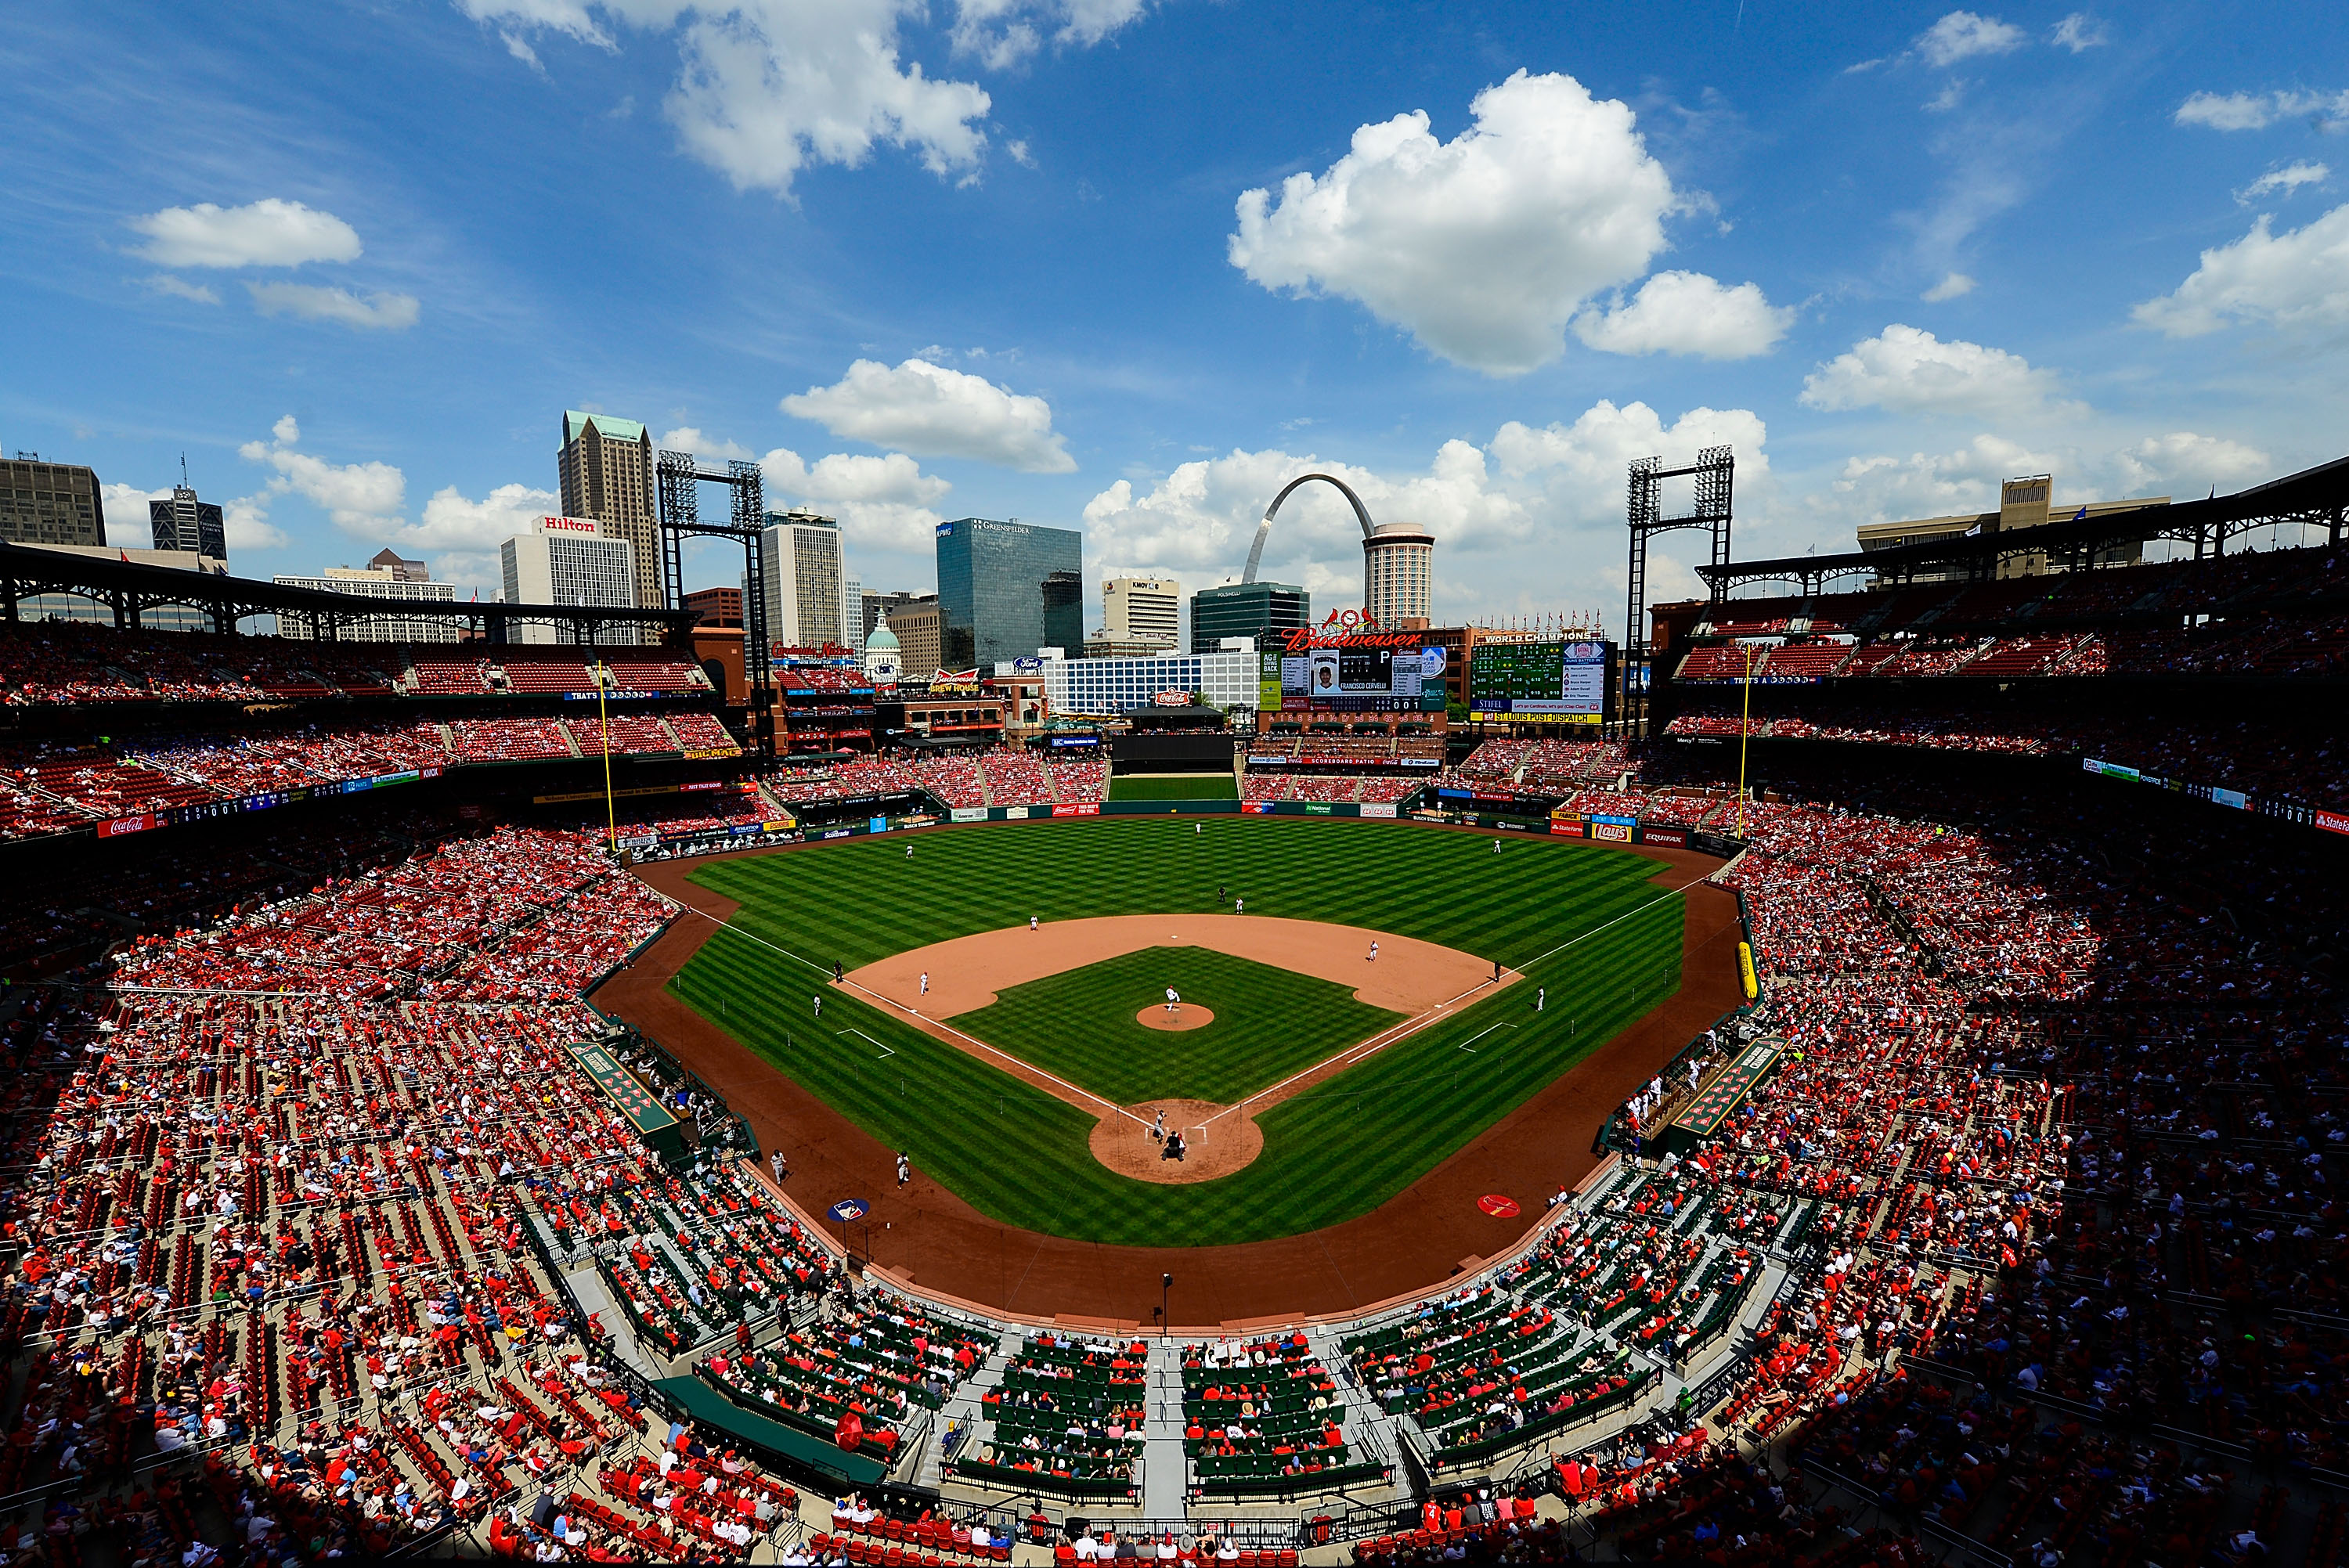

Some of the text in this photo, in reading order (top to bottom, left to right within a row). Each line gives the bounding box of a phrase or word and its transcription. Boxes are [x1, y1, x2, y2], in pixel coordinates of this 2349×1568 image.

[545, 517, 595, 532] Hilton
[983, 521, 1030, 535] GREENSFELDER
[936, 528, 951, 538] KPMG
[1280, 628, 1422, 651] Budweiser
[1485, 632, 1592, 643] WORLD CHAMPIONS
[771, 641, 854, 658] Cardinals Nation
[1019, 658, 1039, 667] Ford
[1380, 651, 1390, 664] P
[933, 674, 979, 683] Budweiser
[930, 684, 952, 693] BREW
[1160, 693, 1185, 704] Coca-Cola
[1479, 699, 1503, 708] STIFEL
[1297, 714, 1303, 723] 6
[1307, 714, 1313, 723] 9
[1318, 714, 1325, 723] 10
[1383, 714, 1394, 723] 42
[1413, 714, 1423, 723] 85
[1529, 713, 1588, 722] POST-DISPATCH
[691, 751, 709, 759] BIG
[423, 767, 438, 778] KMOX
[2140, 774, 2161, 785] POWERADE
[211, 804, 237, 816] 0 0 1
[1558, 812, 1579, 820] FABICK
[2287, 809, 2312, 825] 0 0 1
[110, 816, 143, 834] Coca-Cola
[824, 830, 850, 839] Scottrade
[1597, 825, 1626, 838] Lay's
[1645, 833, 1683, 843] EQUIFAX
[1429, 1509, 1434, 1519] 4
